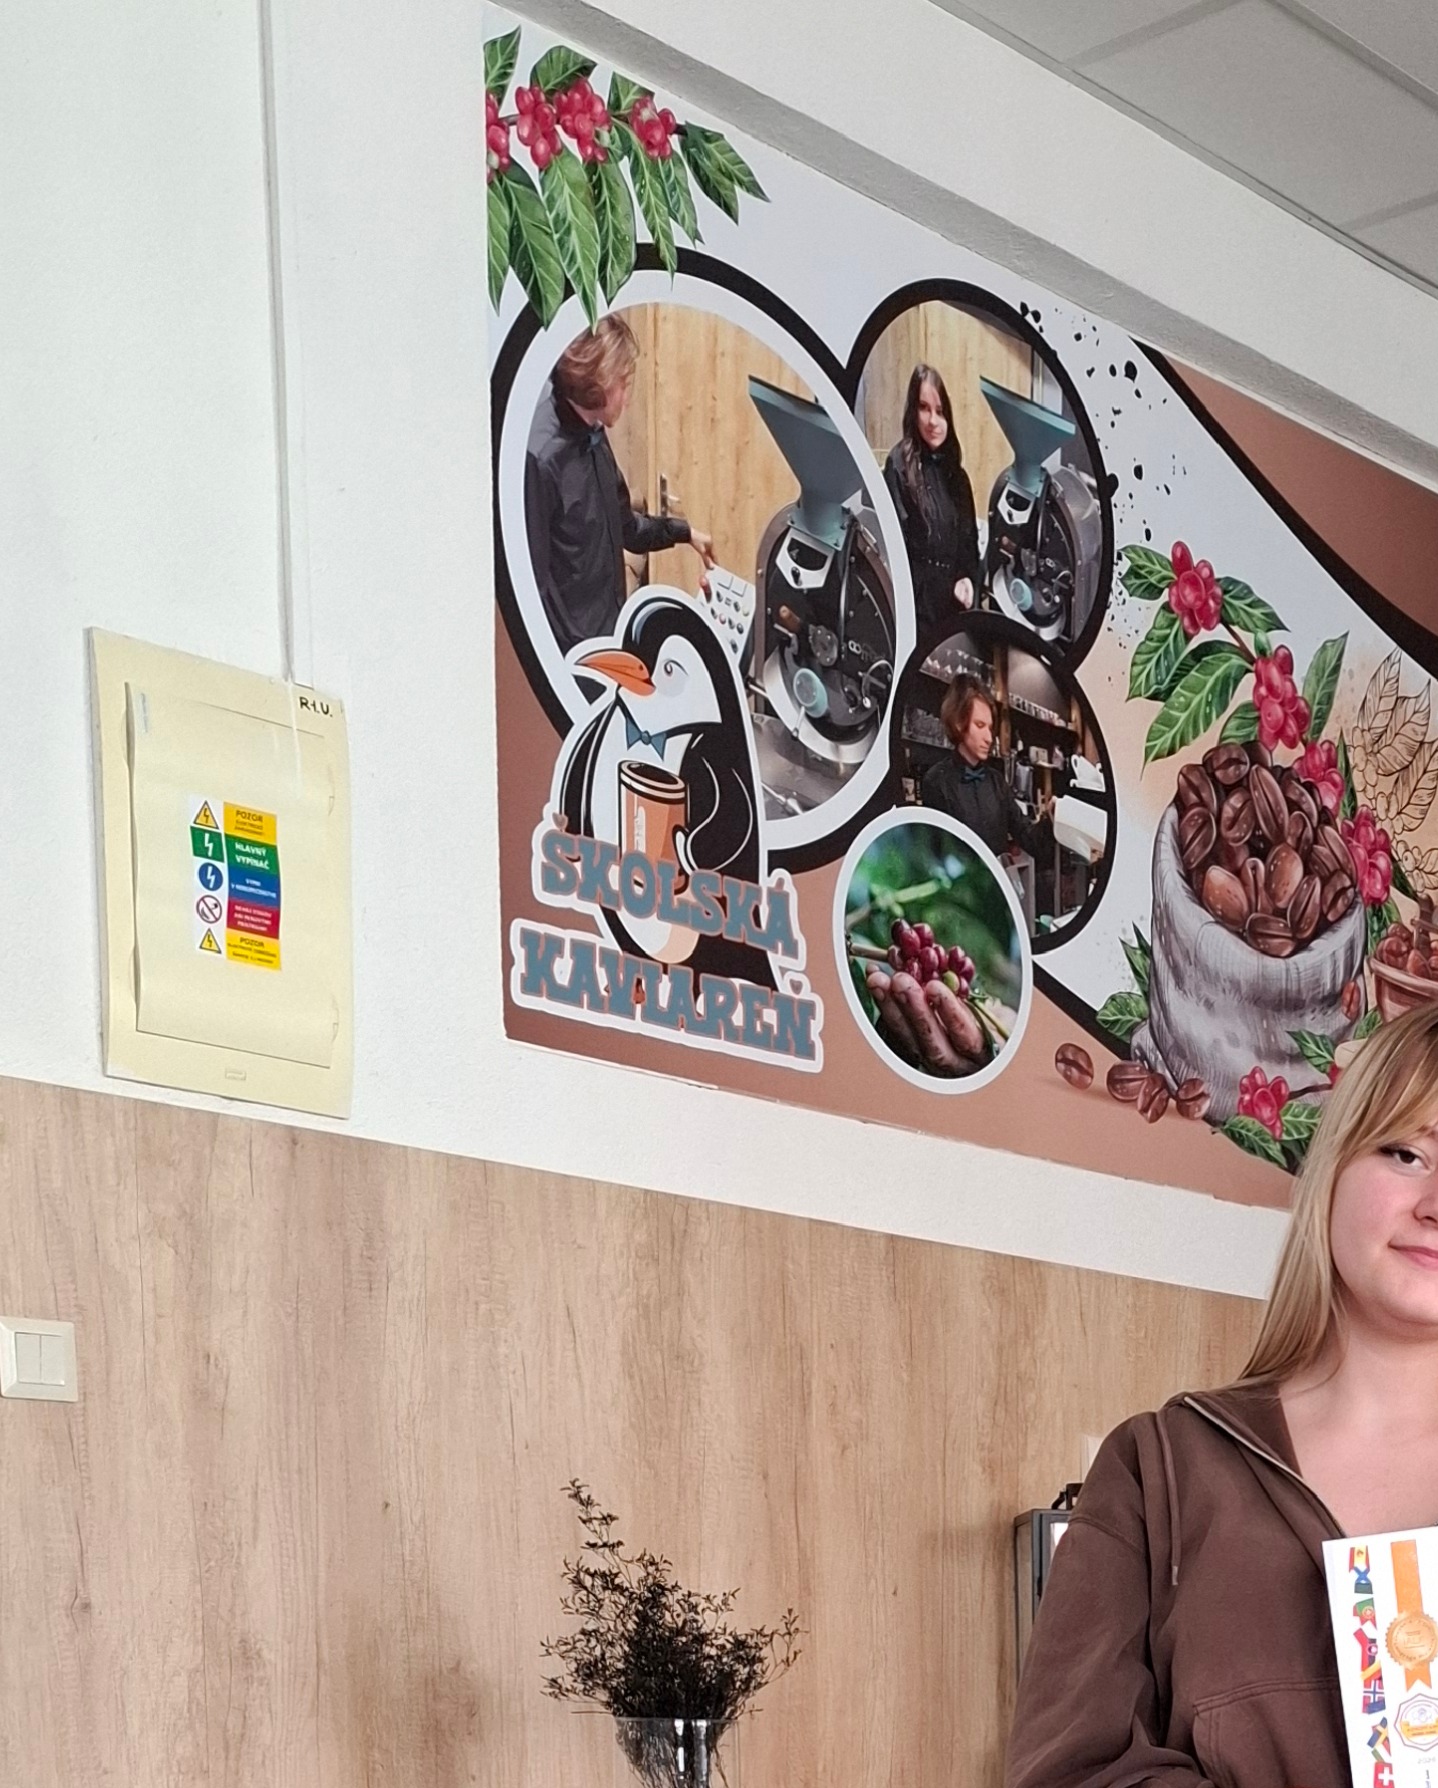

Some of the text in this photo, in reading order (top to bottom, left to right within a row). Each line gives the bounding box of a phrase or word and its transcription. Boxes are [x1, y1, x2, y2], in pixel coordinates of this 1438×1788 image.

[236, 810, 263, 822] POZOR
[541, 812, 799, 959] ŠKOLSKÁ
[519, 926, 817, 1061] KAVIAREŇ
